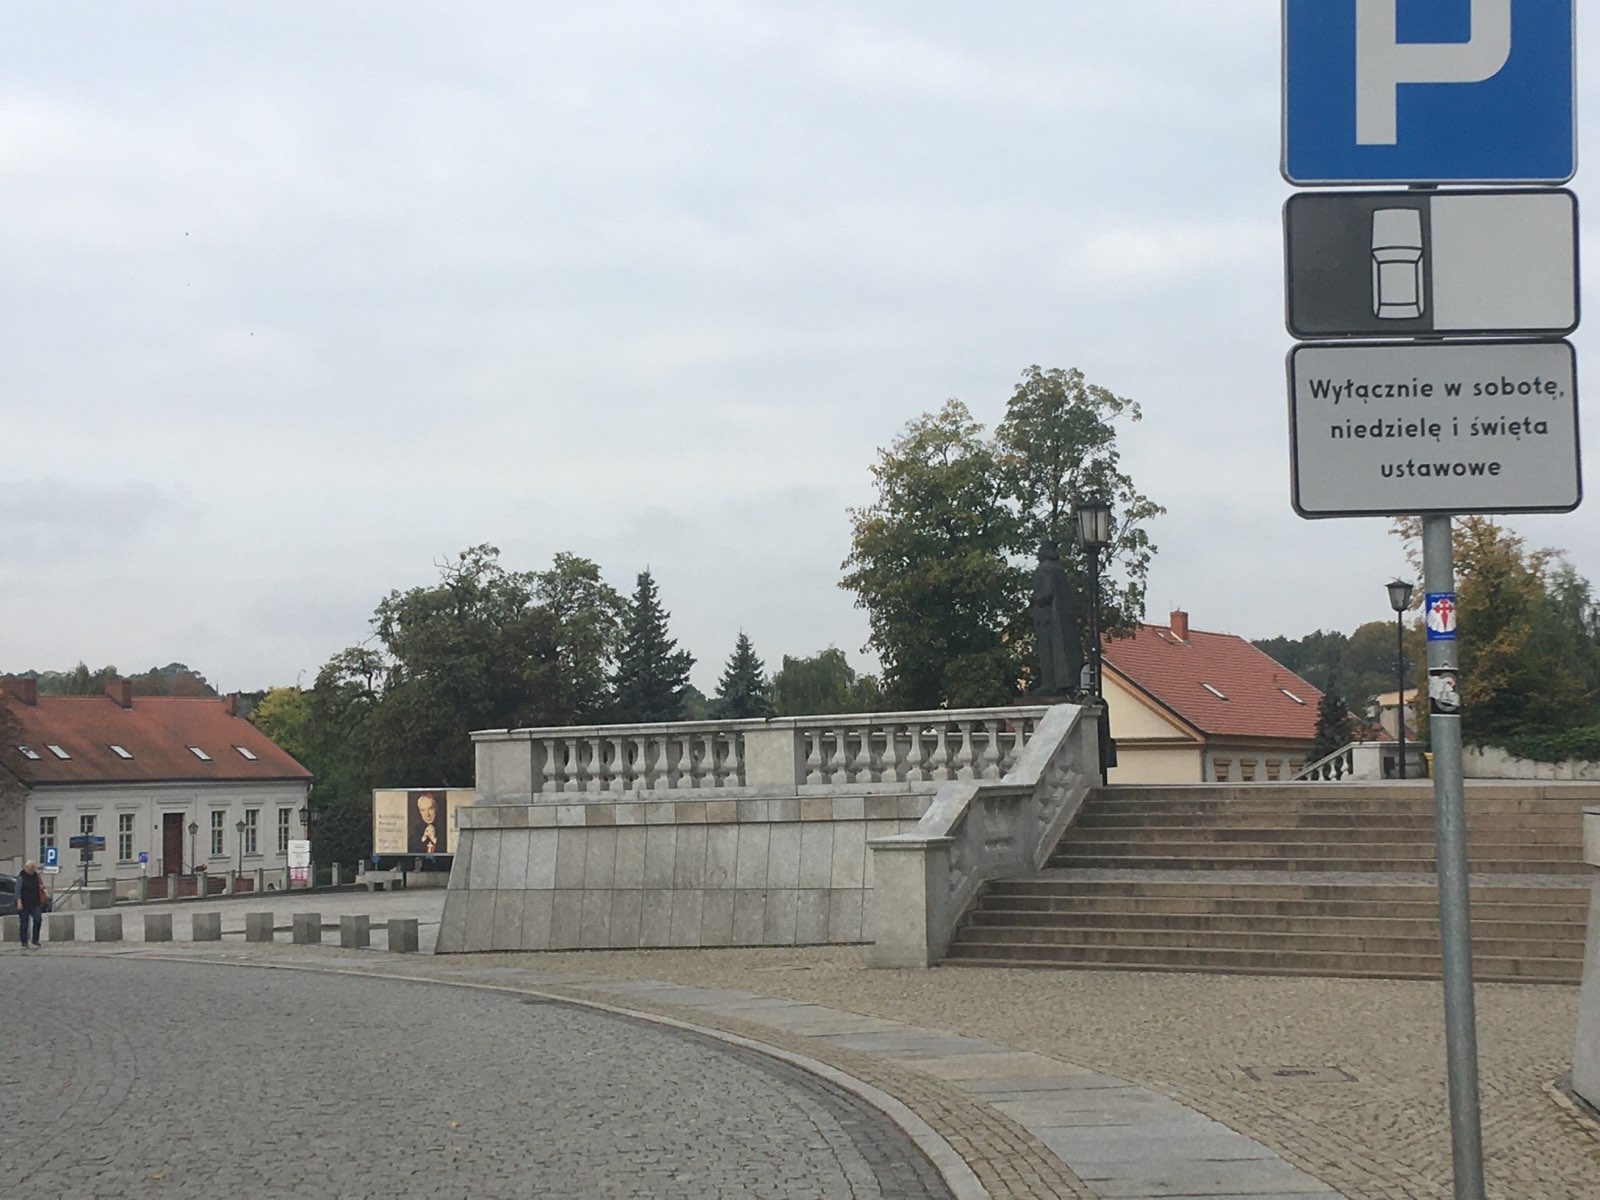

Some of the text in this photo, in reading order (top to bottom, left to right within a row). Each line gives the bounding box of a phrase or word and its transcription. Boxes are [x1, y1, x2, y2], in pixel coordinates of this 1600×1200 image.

[1355, 0, 1511, 145] P
[1309, 376, 1565, 405] Wyłącznie w sobotę,
[1331, 416, 1549, 442] niedzielę i święta
[1380, 458, 1501, 478] ustawowe
[47, 848, 56, 863] P
